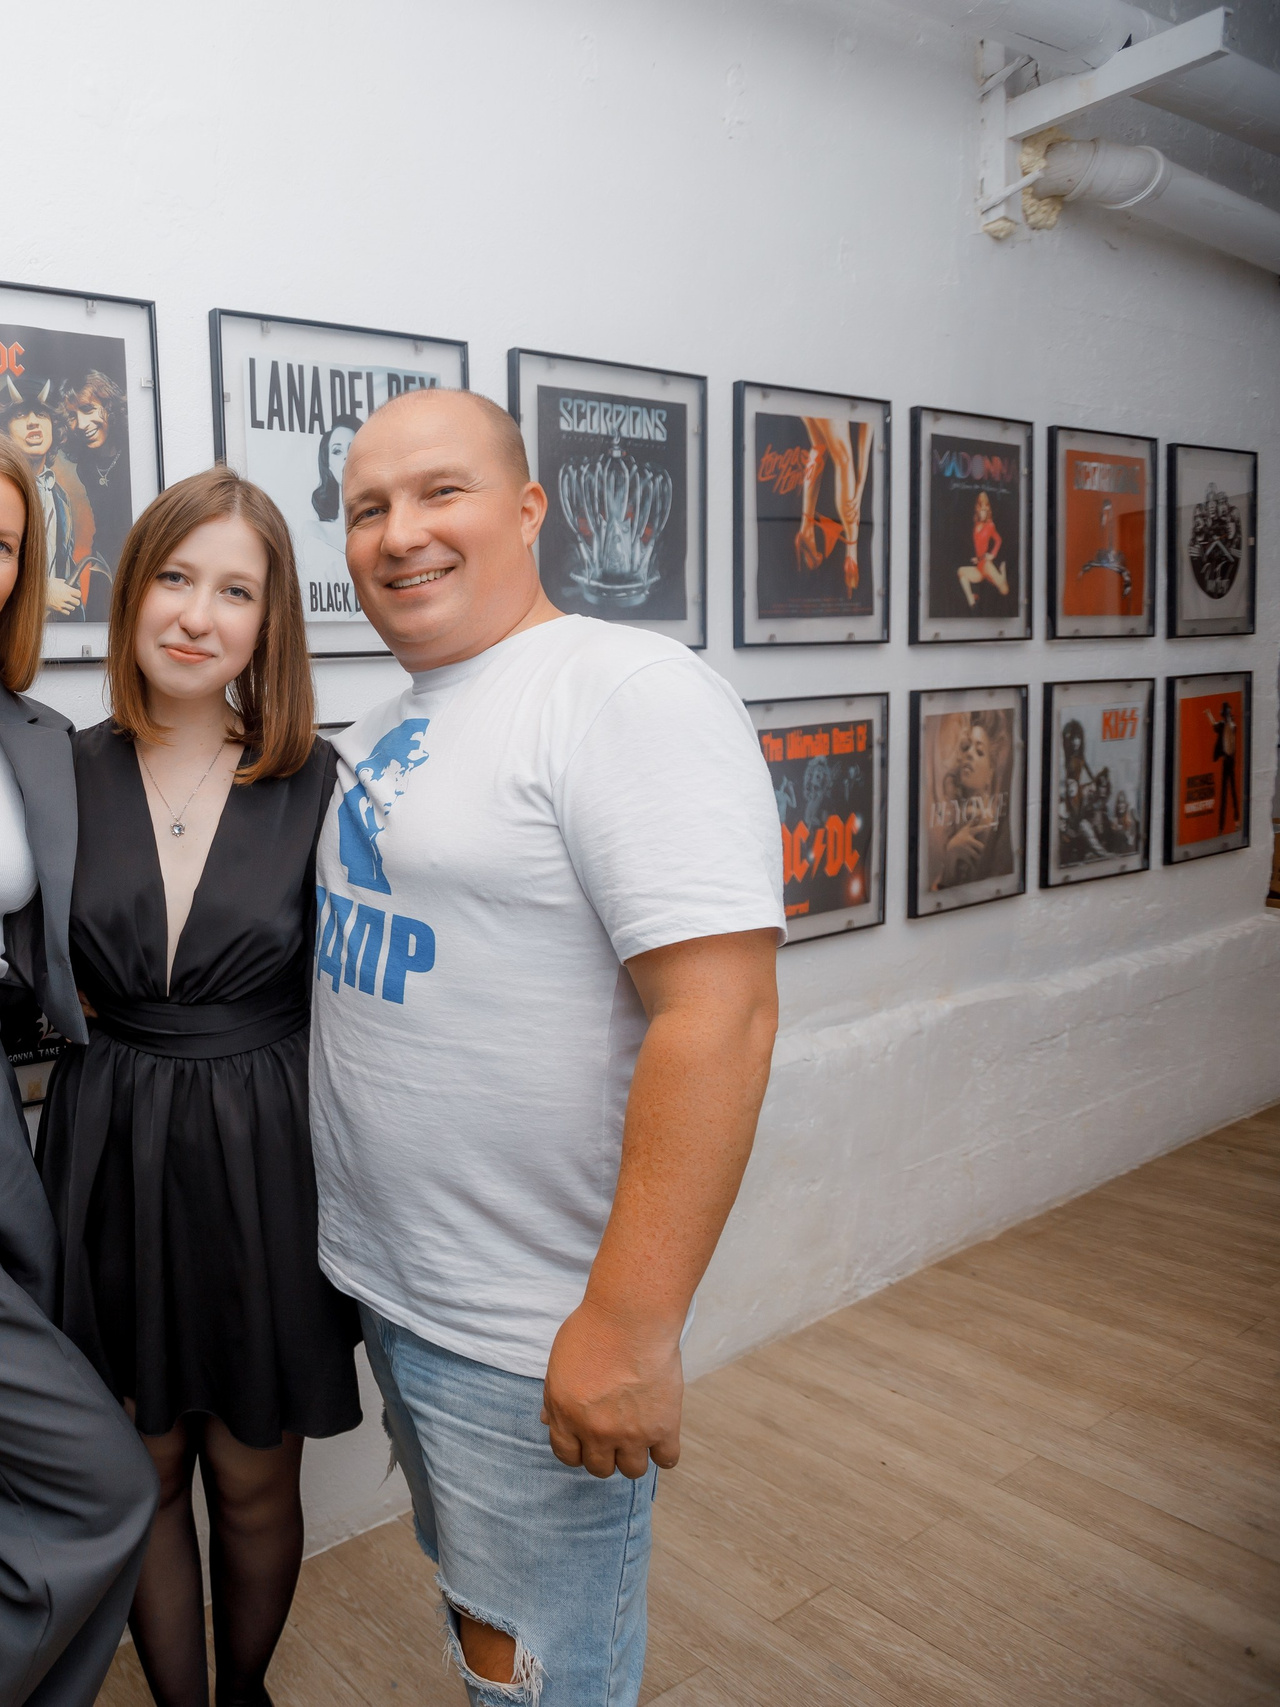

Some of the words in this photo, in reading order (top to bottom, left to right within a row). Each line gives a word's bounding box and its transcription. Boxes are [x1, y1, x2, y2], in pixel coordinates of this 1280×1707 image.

[249, 357, 326, 435] LANA
[559, 397, 668, 442] SCORPIONS
[309, 581, 352, 613] BLACK
[1102, 708, 1140, 742] KISS
[37, 1046, 60, 1057] TAKE
